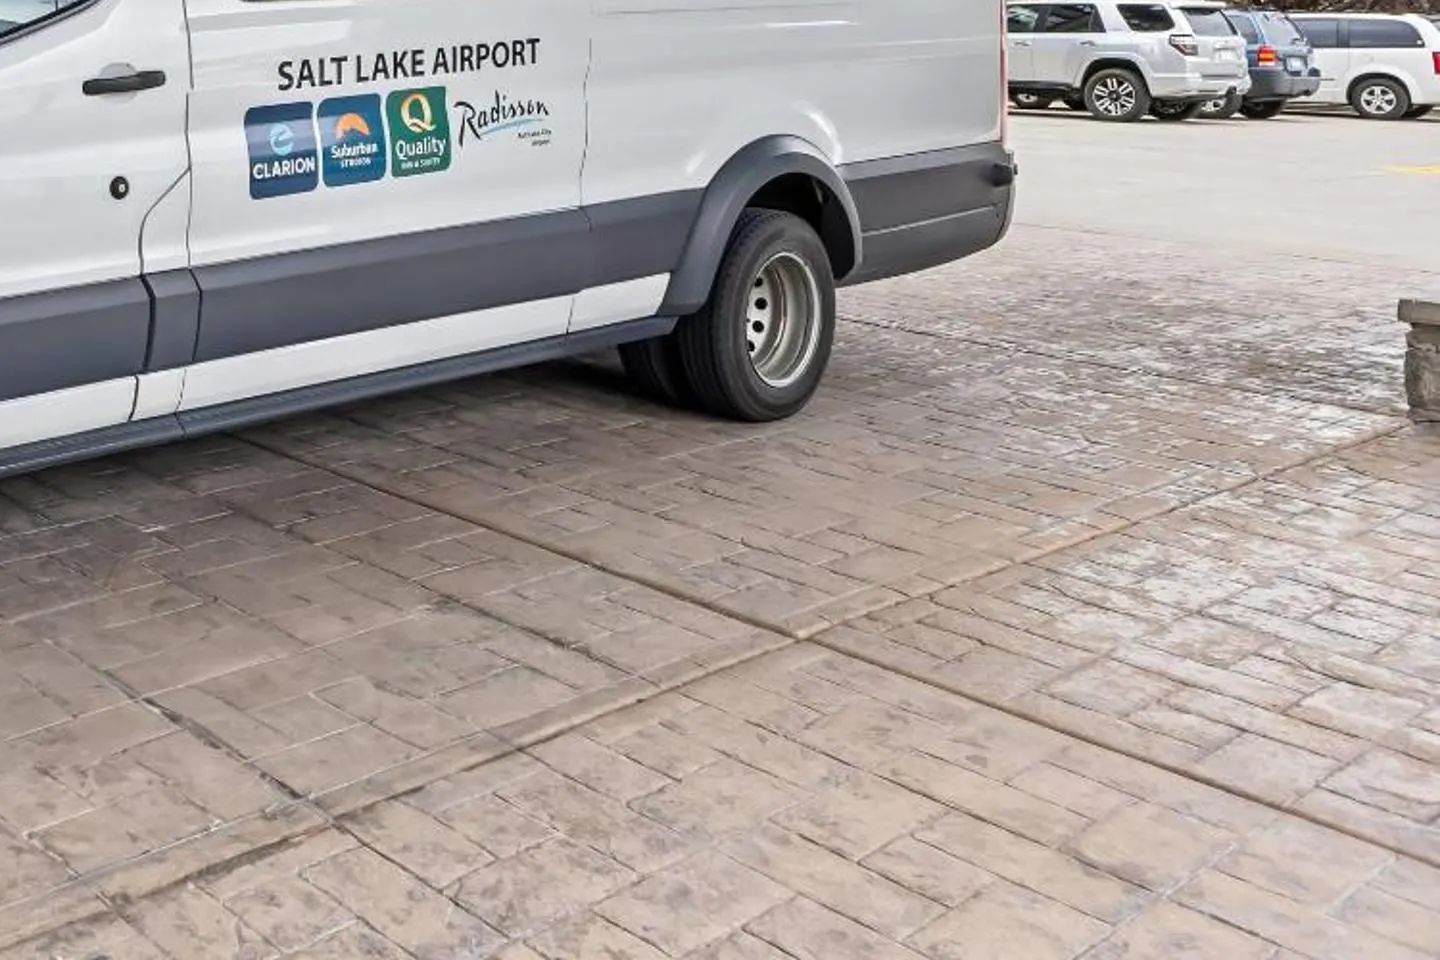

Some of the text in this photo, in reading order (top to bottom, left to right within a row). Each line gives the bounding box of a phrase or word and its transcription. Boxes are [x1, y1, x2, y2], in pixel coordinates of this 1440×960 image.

[278, 38, 541, 91] SALT LAKE AIRPORT
[400, 93, 436, 133] Q
[453, 89, 549, 149] Radisson
[252, 156, 316, 179] CLARION
[395, 136, 447, 160] Quality
